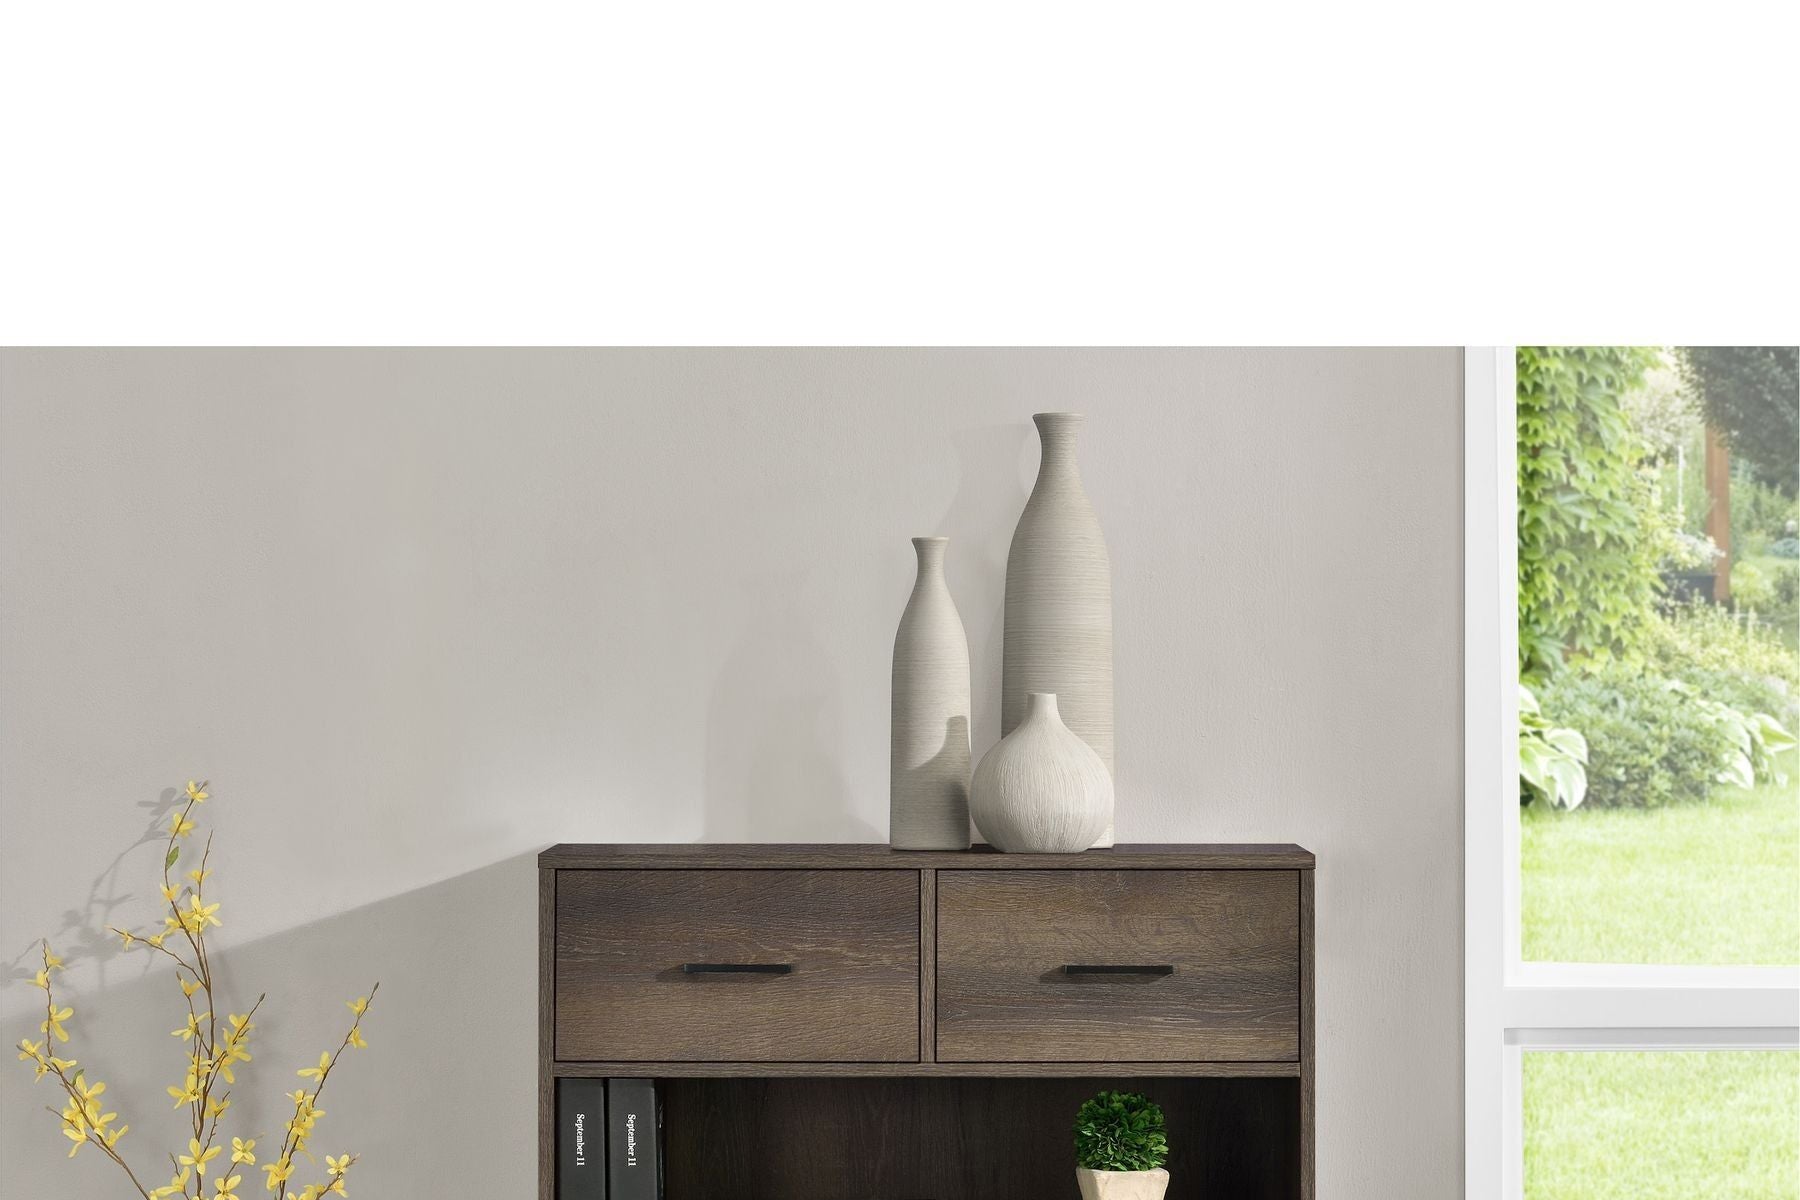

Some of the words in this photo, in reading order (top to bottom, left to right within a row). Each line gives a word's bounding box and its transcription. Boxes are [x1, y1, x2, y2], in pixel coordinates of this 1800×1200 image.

[575, 1113, 585, 1156] September
[626, 1113, 636, 1156] September
[576, 1157, 585, 1166] 11
[627, 1157, 636, 1166] 11
